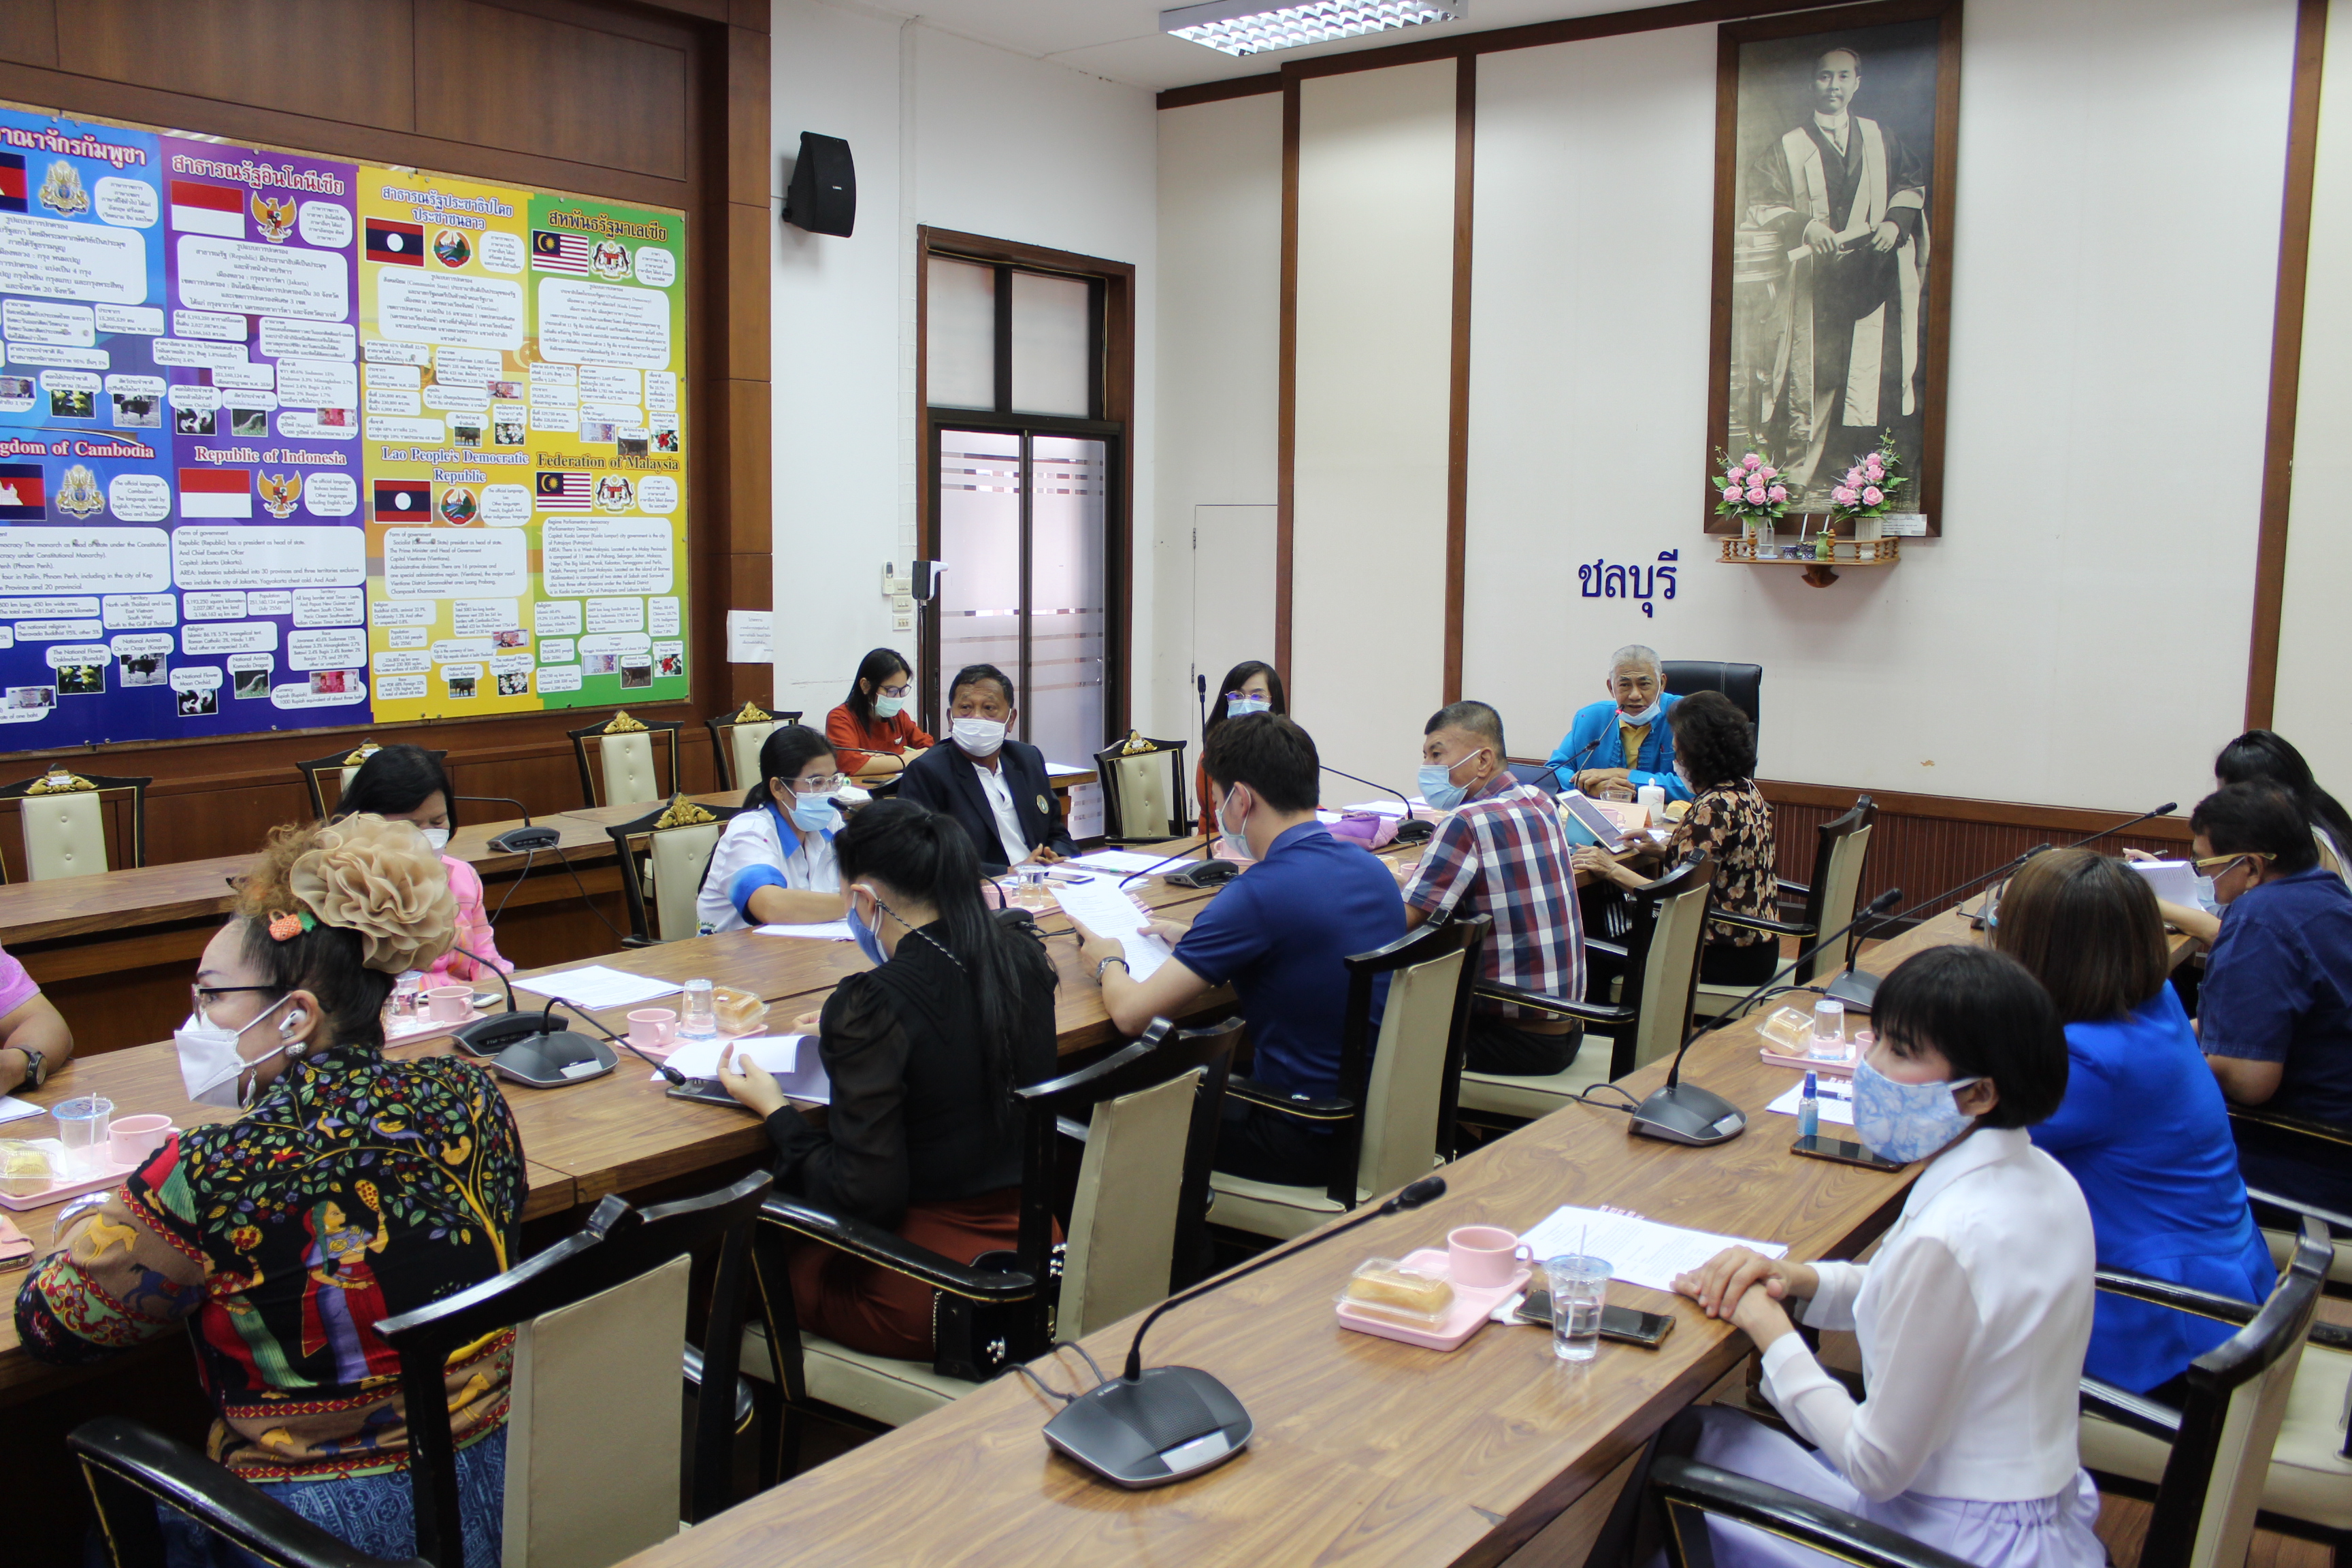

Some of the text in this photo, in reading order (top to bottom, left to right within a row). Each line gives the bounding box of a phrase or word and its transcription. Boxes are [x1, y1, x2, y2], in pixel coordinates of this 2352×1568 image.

[0, 127, 147, 169] าณาจักรกัมพูชา
[173, 156, 344, 195] สาธารณรัฐอินโดนีเซีย
[412, 208, 485, 229] ประชาชนลาว
[549, 209, 668, 241] สหพันธรัฐมาเลเซีย
[52, 440, 69, 455] of
[74, 441, 154, 459] Cambodia
[195, 446, 347, 466] Republic of Indonesia
[382, 447, 408, 460] Lao
[463, 451, 529, 464] Democratic
[536, 453, 679, 474] Federation of Malaysia
[434, 468, 487, 485] Republic
[1578, 549, 1678, 618] ชลบุรี
